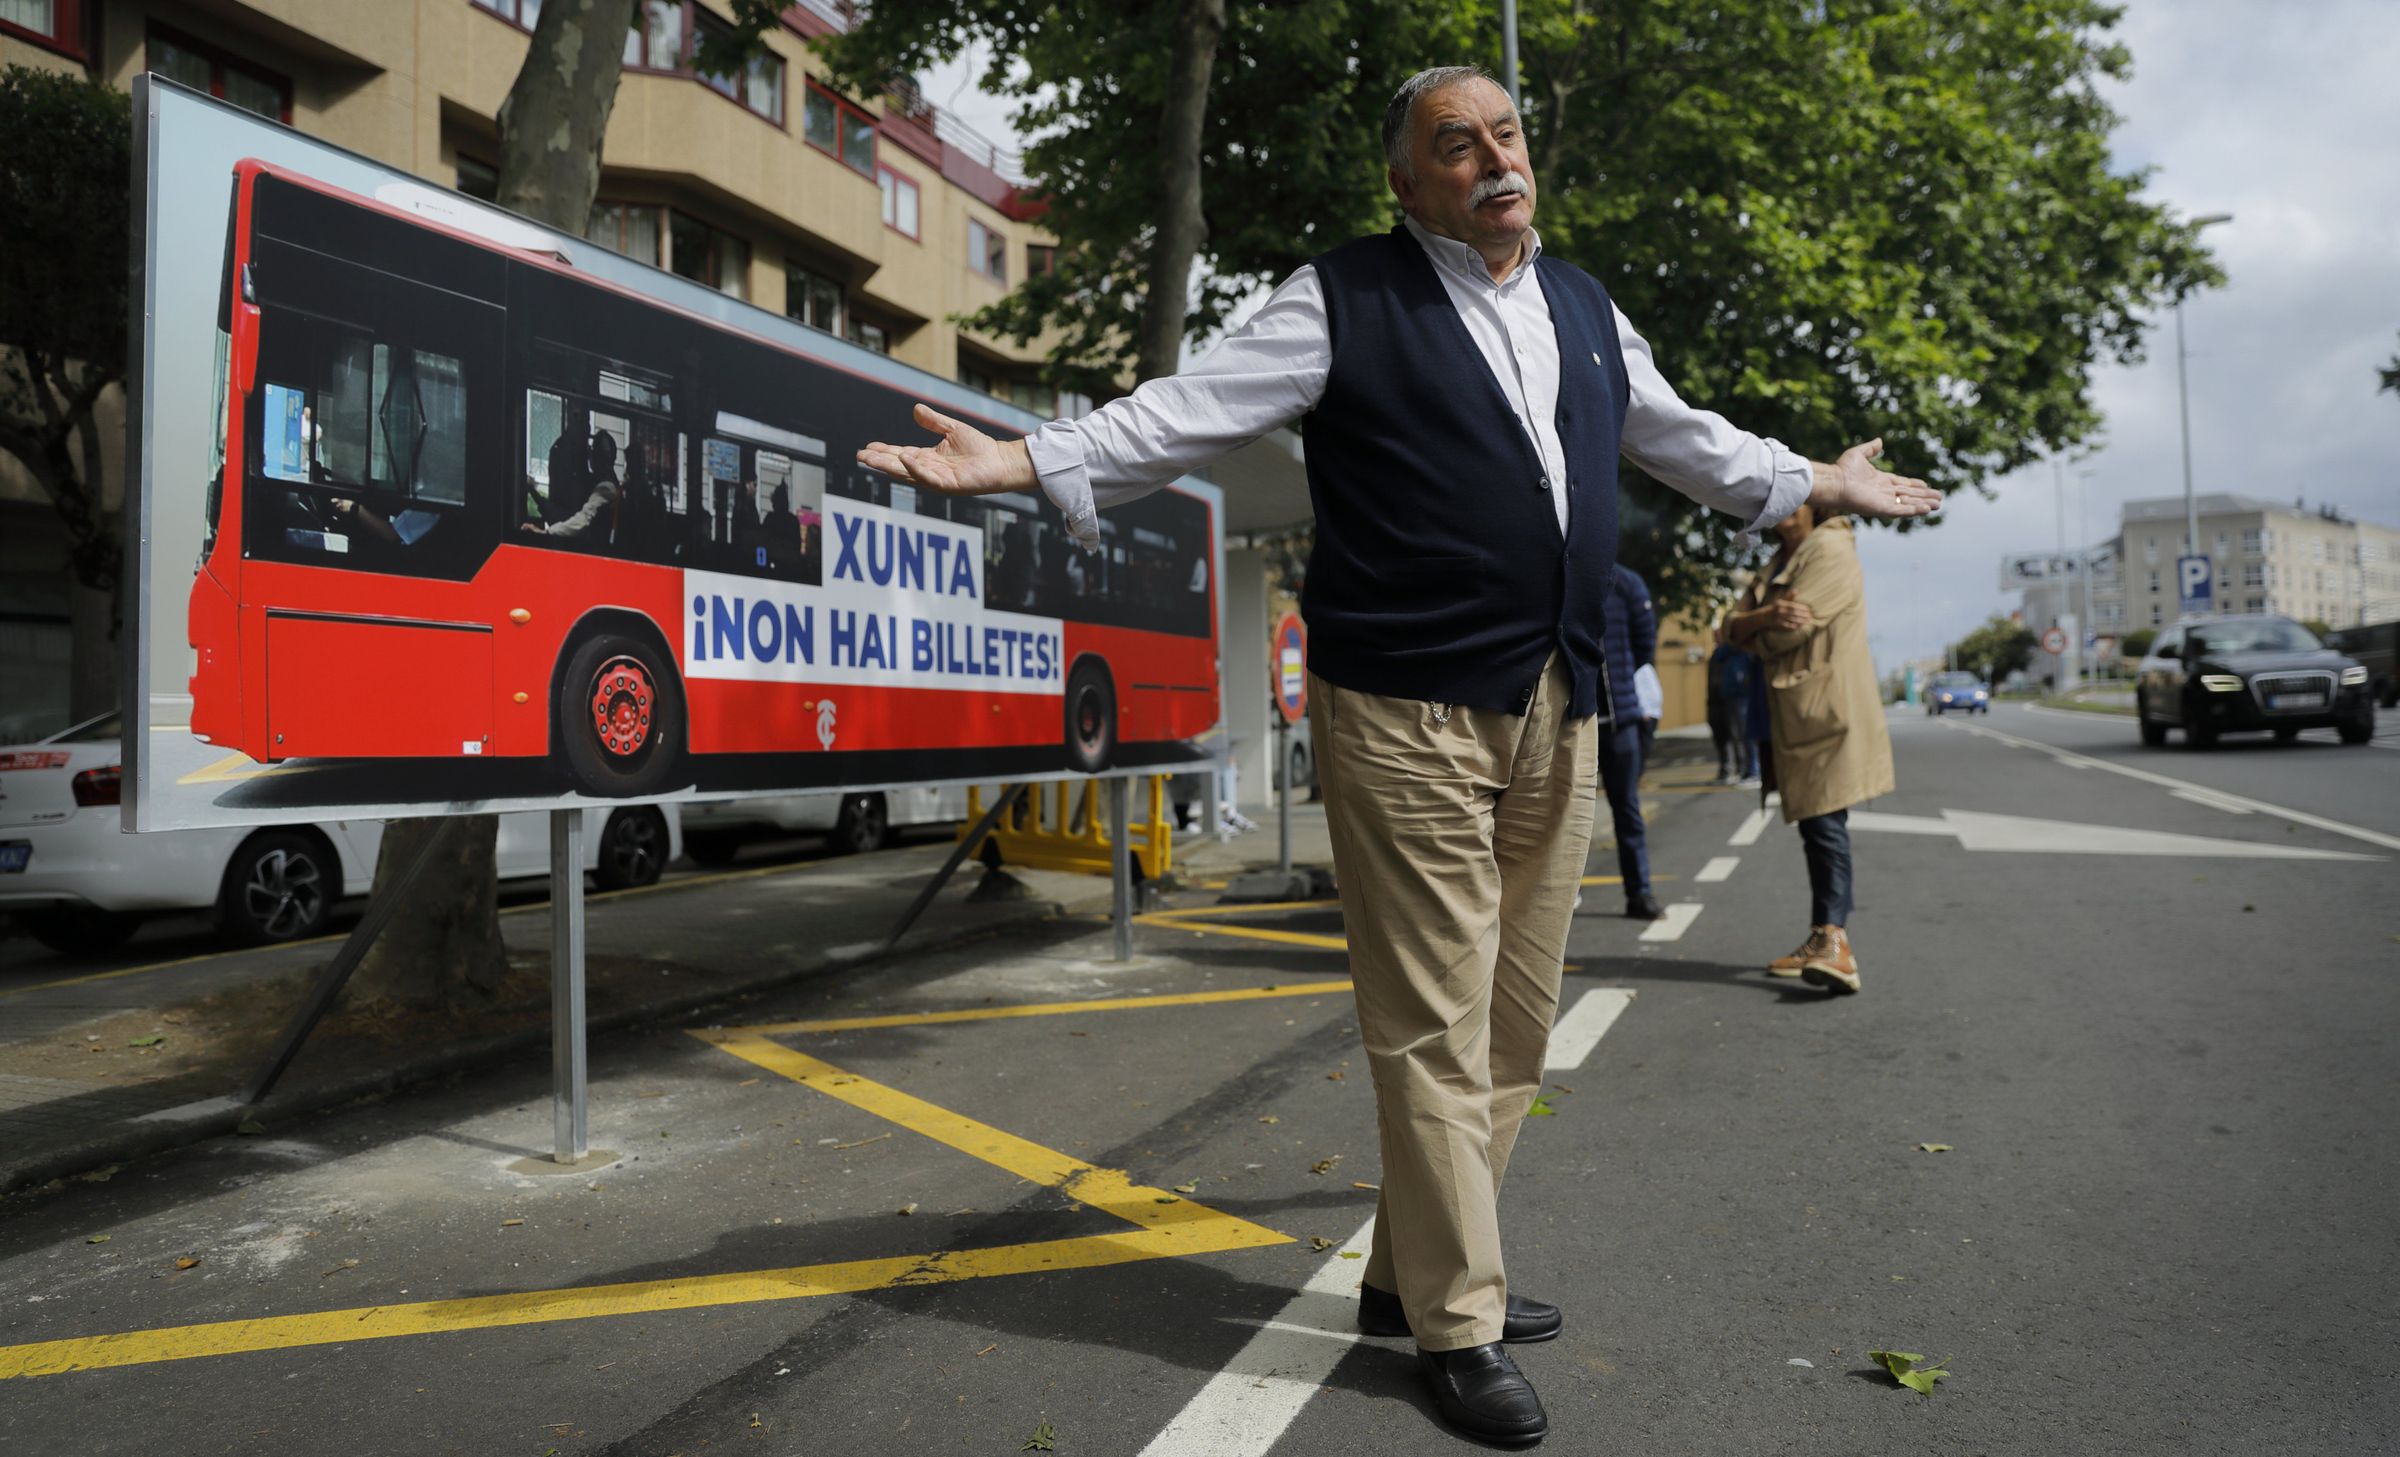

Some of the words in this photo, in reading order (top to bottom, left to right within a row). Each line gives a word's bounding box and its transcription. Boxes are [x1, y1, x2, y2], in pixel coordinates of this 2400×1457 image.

[832, 512, 977, 599] XUNTA
[2181, 559, 2208, 597] P
[693, 595, 814, 664] ¡NON
[830, 608, 897, 670] HAI
[912, 619, 1059, 680] BILLETES!
